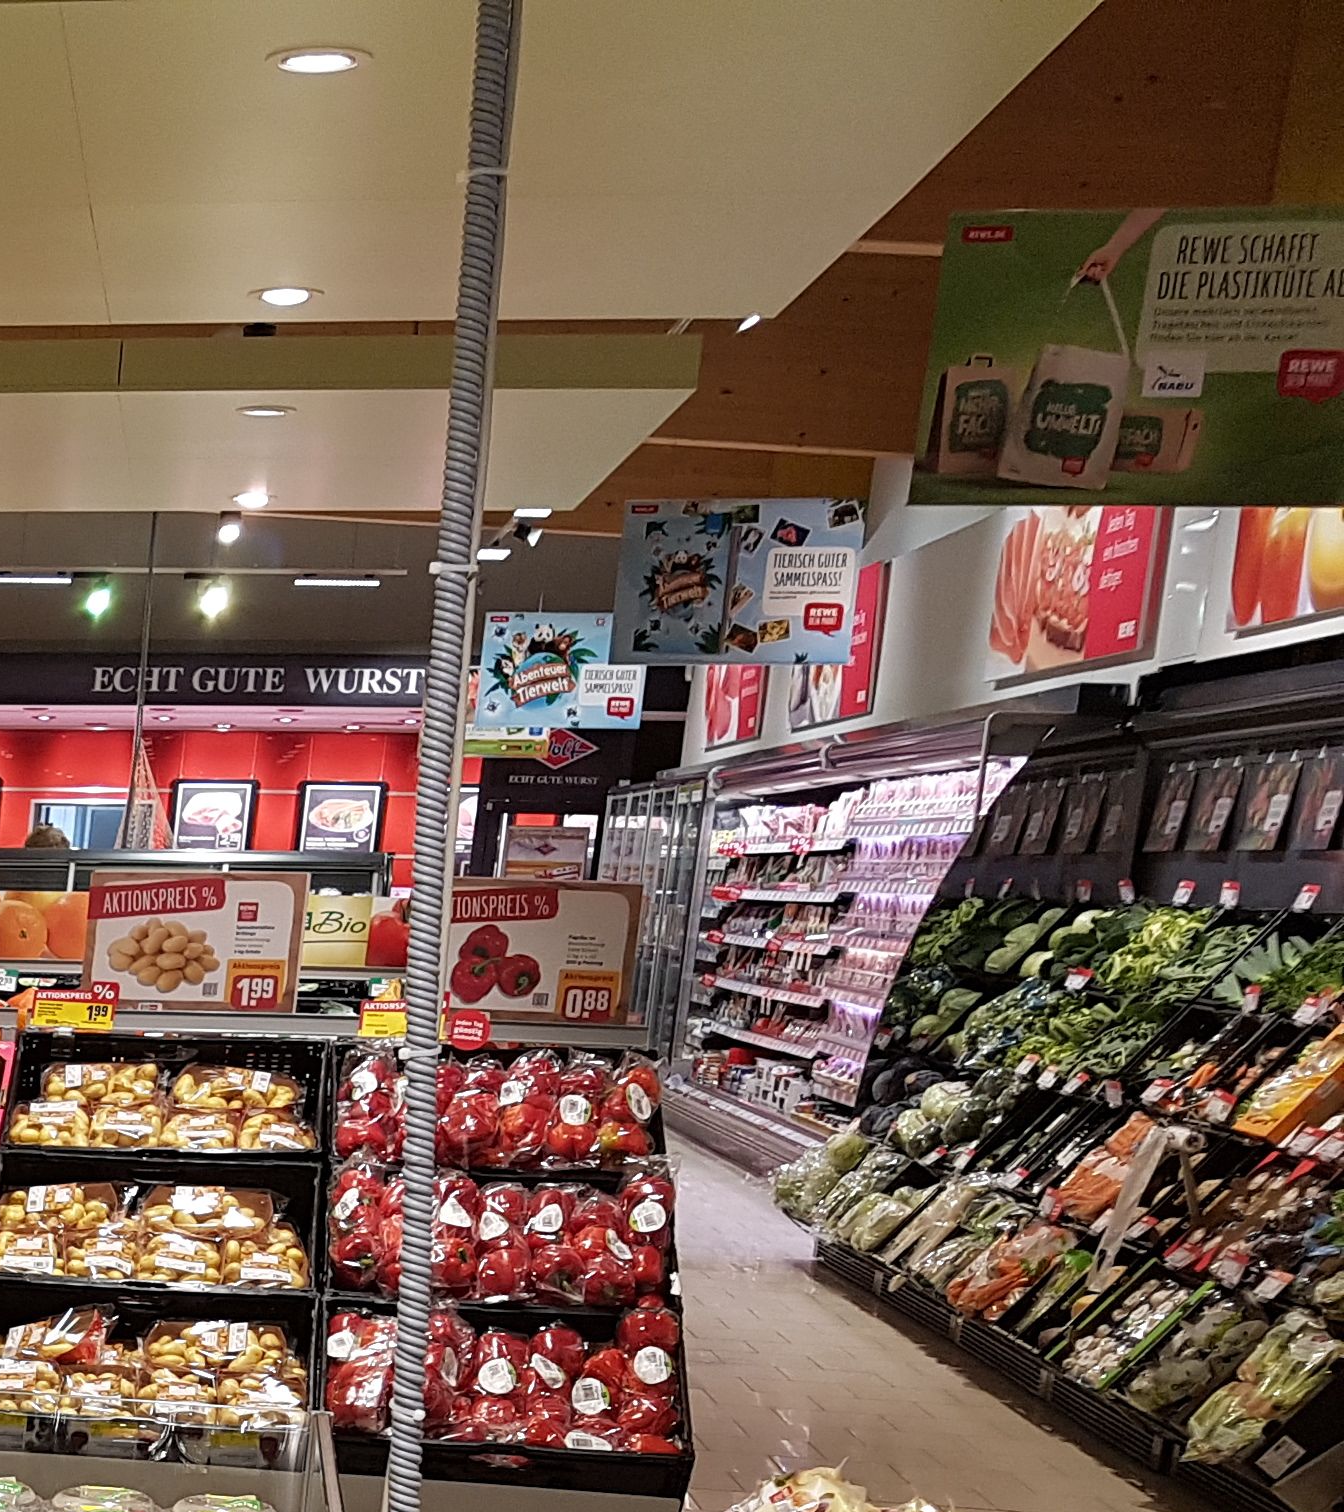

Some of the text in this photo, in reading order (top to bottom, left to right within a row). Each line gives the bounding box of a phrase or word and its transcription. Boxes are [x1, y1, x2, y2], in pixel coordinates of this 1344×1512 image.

[1177, 233, 1320, 265] REWE SCHAFFT
[1158, 271, 1191, 299] DIE
[1196, 266, 1321, 299] PLASTIKTÜTE
[1288, 359, 1337, 372] REWE
[1157, 382, 1194, 391] NABU
[773, 553, 848, 569] TIERISCH GUTER
[773, 571, 842, 587] SAMMELSPASS!
[810, 608, 838, 617] REWE
[91, 666, 425, 695] ECHT GUTE WURST
[513, 663, 567, 687] Abenteuer
[616, 669, 637, 680] GUTER
[517, 678, 570, 703] Tierwelt
[509, 776, 599, 784] ECHT GUTE WURST
[103, 886, 217, 914] AKTIONSPREIS %
[534, 896, 550, 915] %
[313, 911, 366, 935] Bio
[93, 985, 114, 999] %
[236, 978, 274, 1007] 1.99
[565, 989, 608, 1019] 0.88
[86, 1006, 108, 1022] 1.99
